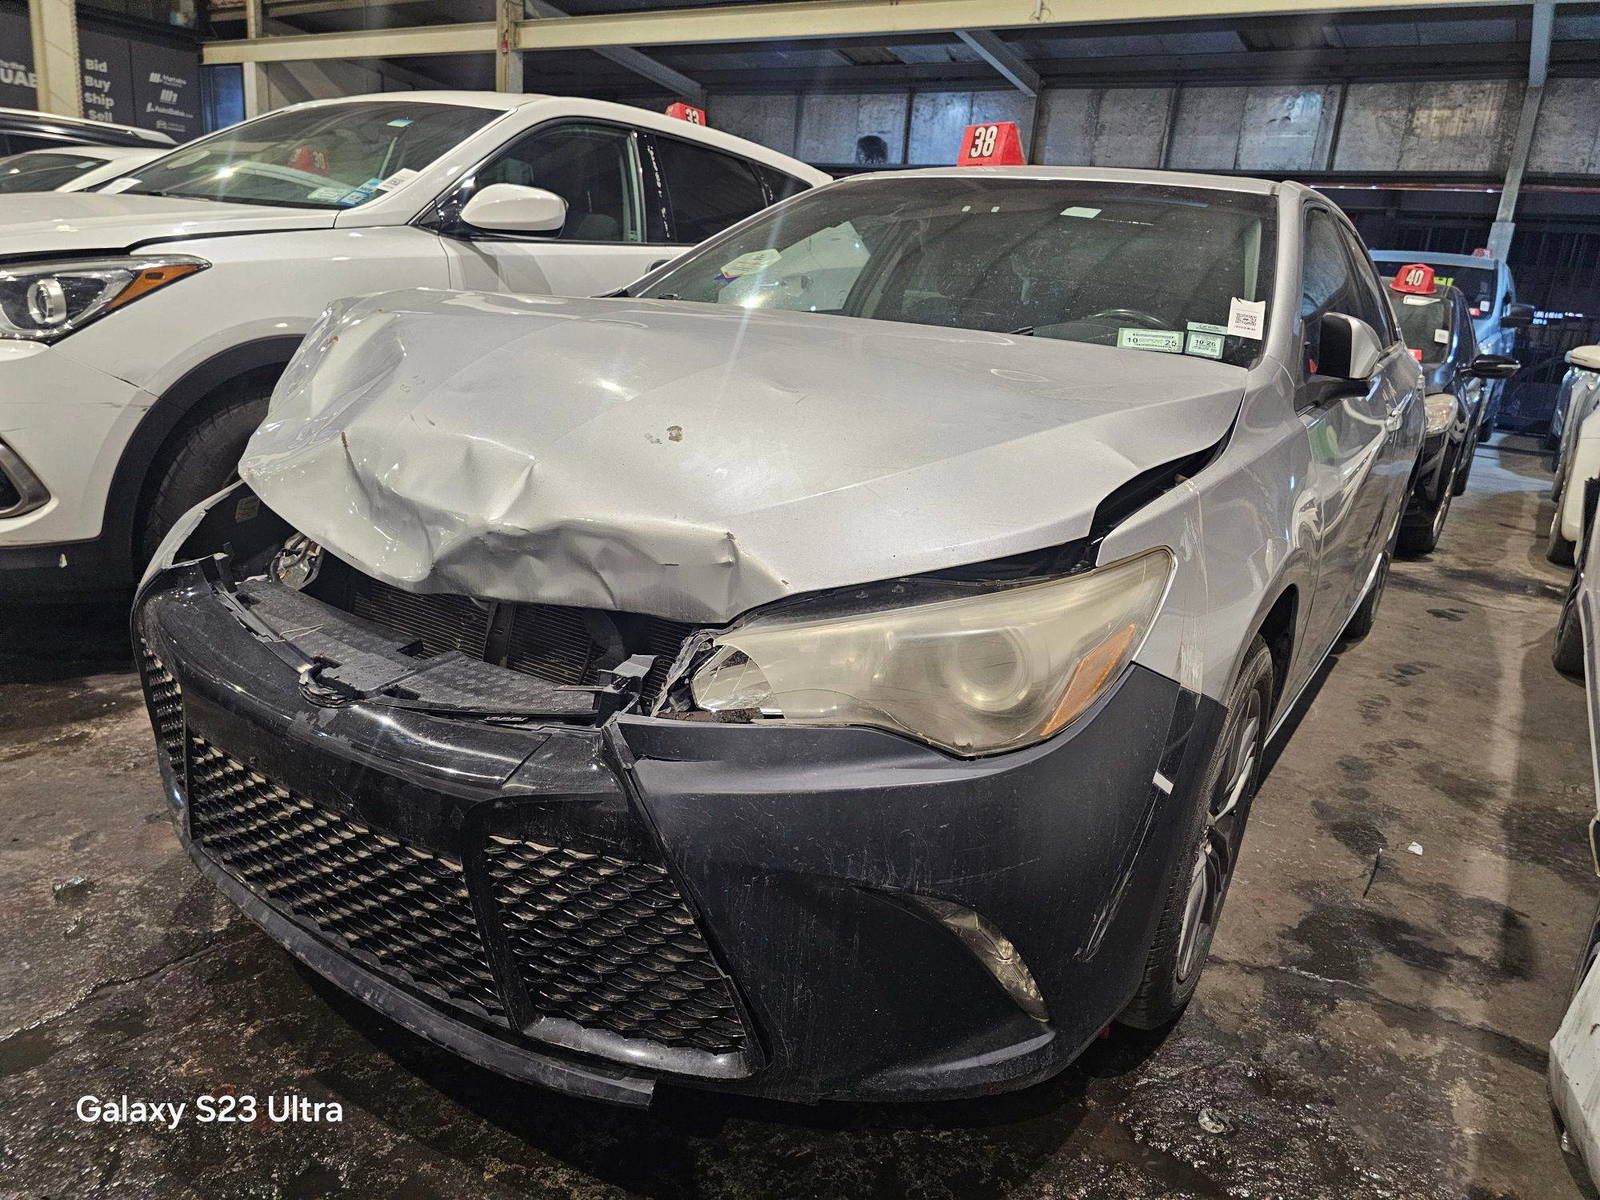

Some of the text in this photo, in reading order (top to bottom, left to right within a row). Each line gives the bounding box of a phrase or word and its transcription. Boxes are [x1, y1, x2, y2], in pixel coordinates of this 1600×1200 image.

[85, 58, 107, 73] Bid
[0, 68, 38, 89] UAE
[84, 75, 111, 93] Buy
[84, 92, 114, 110] Ship
[88, 109, 113, 122] Sell
[971, 125, 998, 157] 38
[1405, 269, 1424, 286] 40
